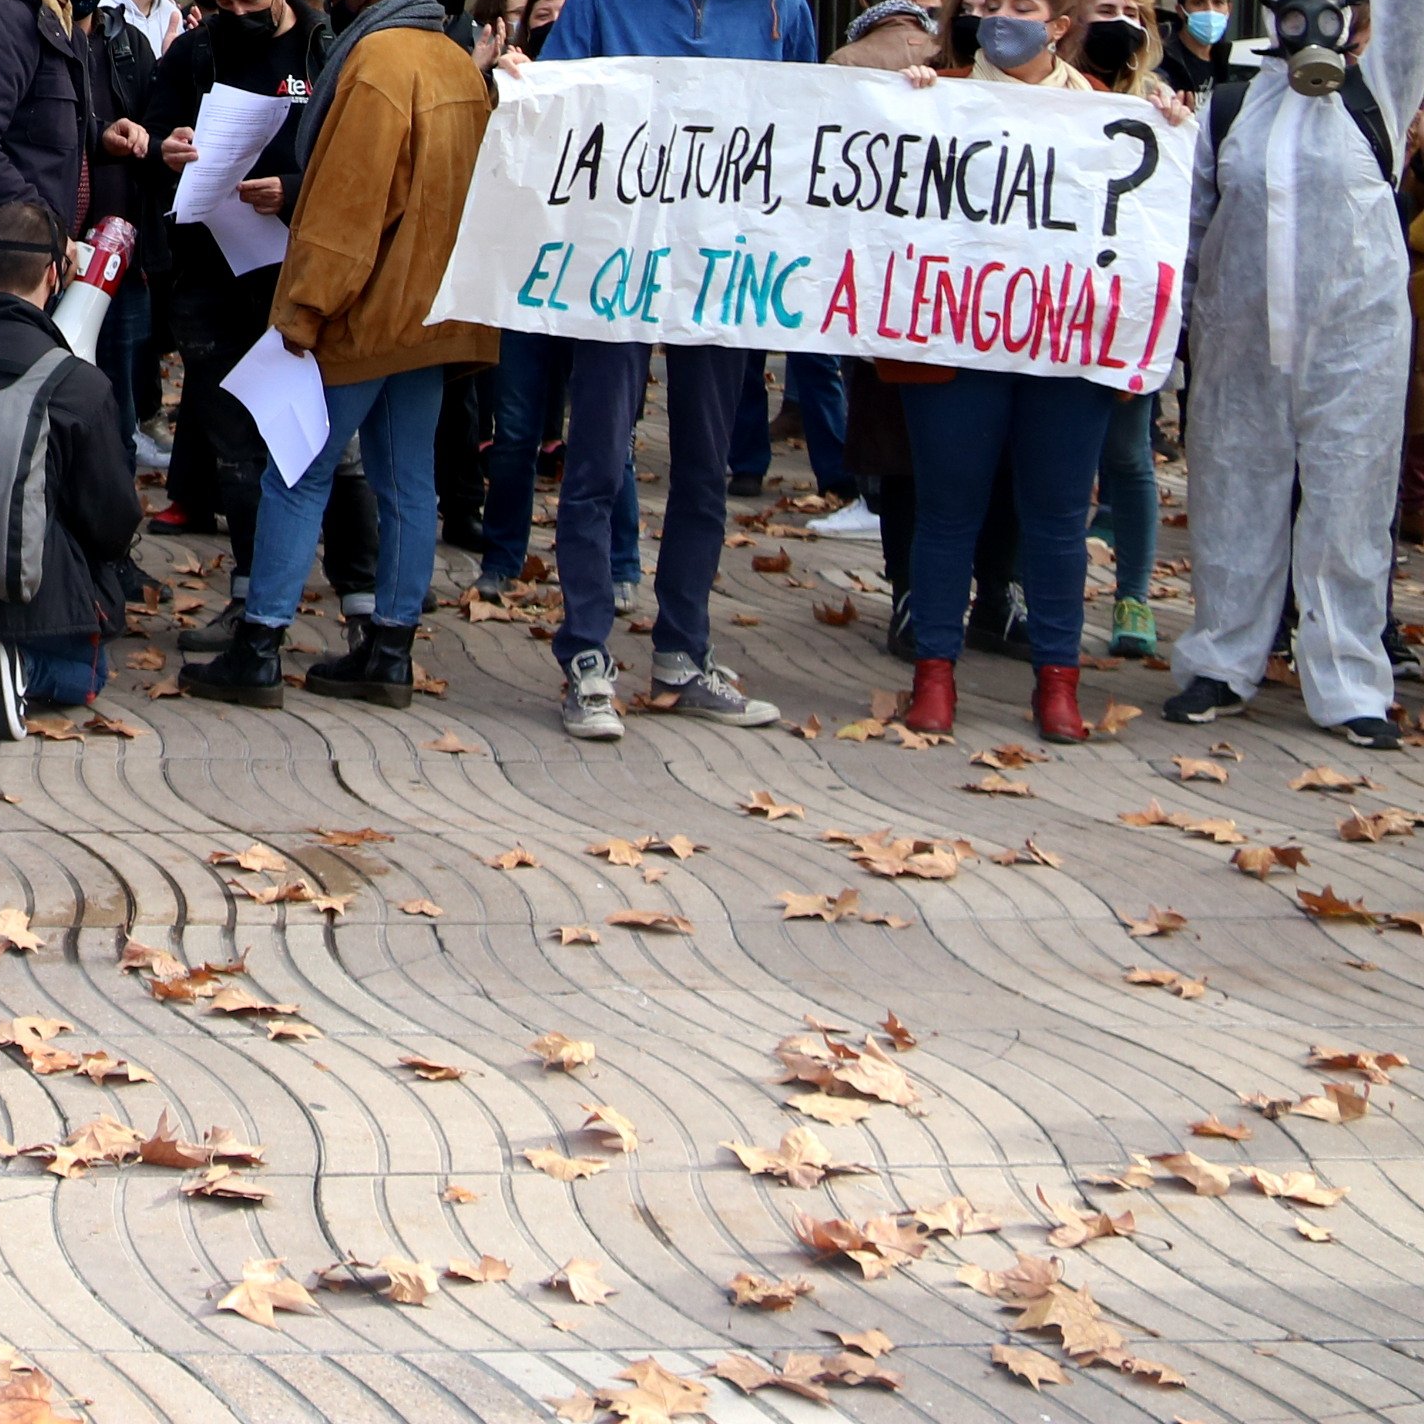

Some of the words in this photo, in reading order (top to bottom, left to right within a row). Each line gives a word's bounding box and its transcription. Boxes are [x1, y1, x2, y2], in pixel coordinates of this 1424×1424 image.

[547, 122, 604, 206] LA
[517, 242, 573, 310] EL
[590, 247, 670, 324] QUE
[820, 248, 858, 335] A
